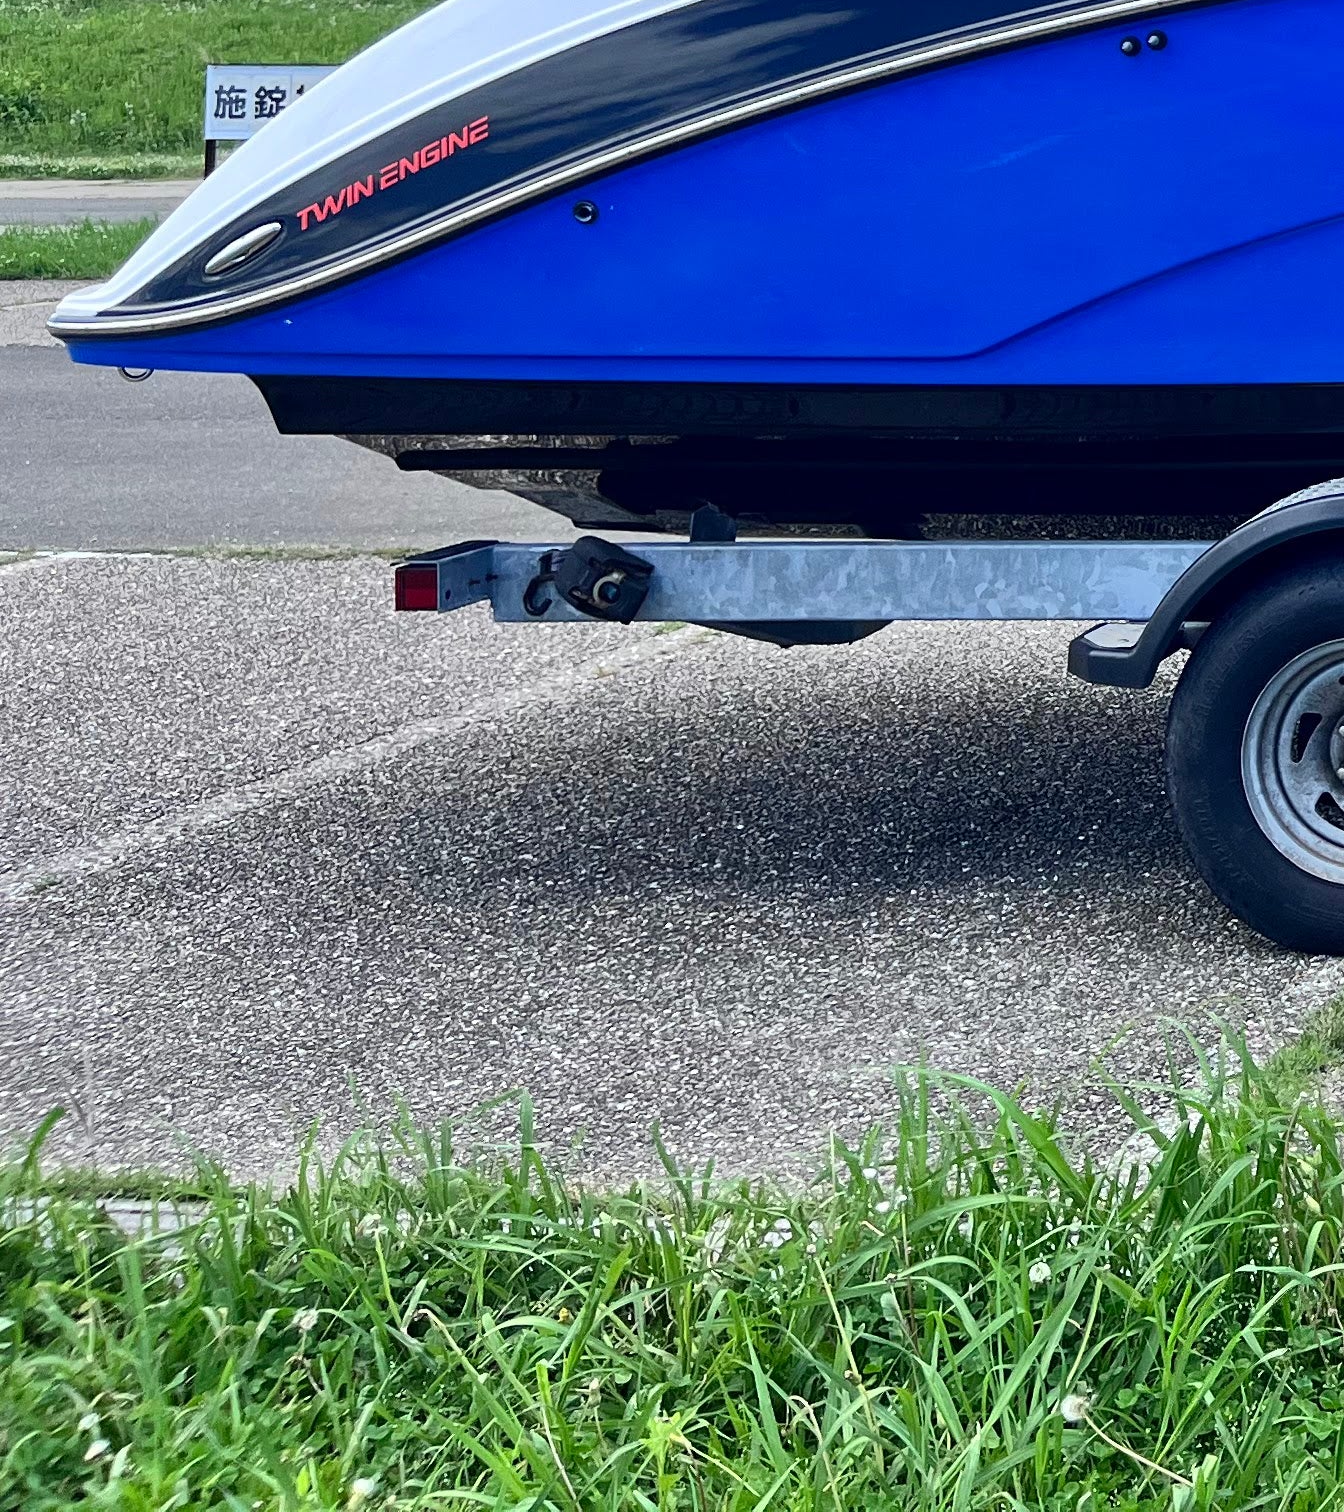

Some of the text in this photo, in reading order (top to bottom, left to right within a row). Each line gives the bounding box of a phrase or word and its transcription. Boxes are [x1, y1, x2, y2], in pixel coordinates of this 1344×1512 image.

[213, 84, 304, 119] 施錠
[296, 115, 490, 231] TWIN ENGINE
